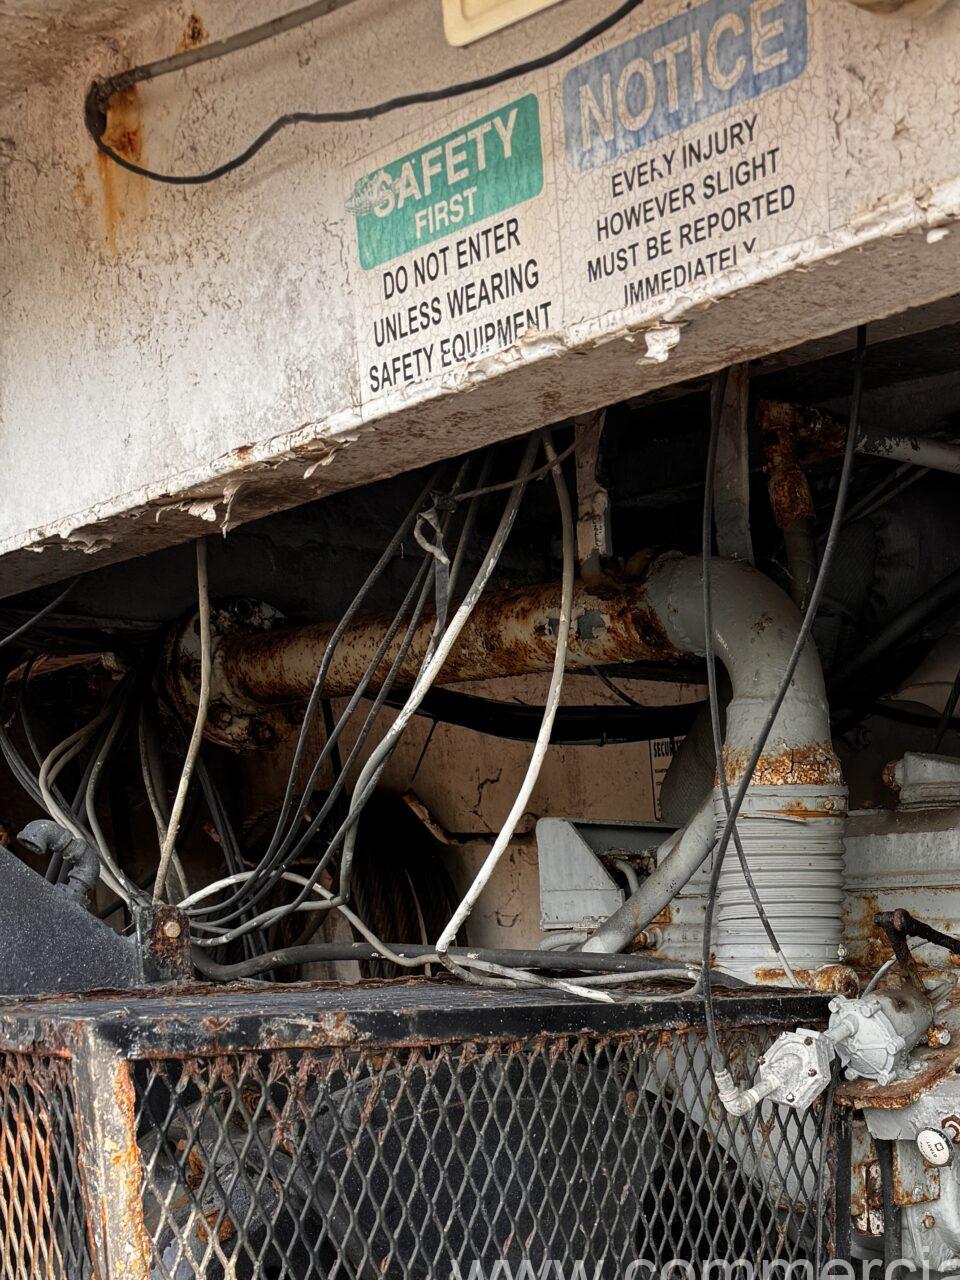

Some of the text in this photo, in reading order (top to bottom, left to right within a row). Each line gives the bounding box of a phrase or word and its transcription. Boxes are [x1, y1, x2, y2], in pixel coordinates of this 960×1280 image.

[579, 0, 788, 151] NOTICE
[372, 108, 518, 218] SAFETY
[596, 147, 780, 242] HOWEVER SLIGHT
[611, 113, 757, 198] EVERY INJURY
[414, 186, 477, 239] FIRST
[587, 184, 795, 283] MUST BE REPORTED
[373, 258, 539, 347] UNLESS WEARING
[383, 218, 521, 300] DO NOT ENTER
[369, 301, 551, 392] SAFETY EQUIPMENT
